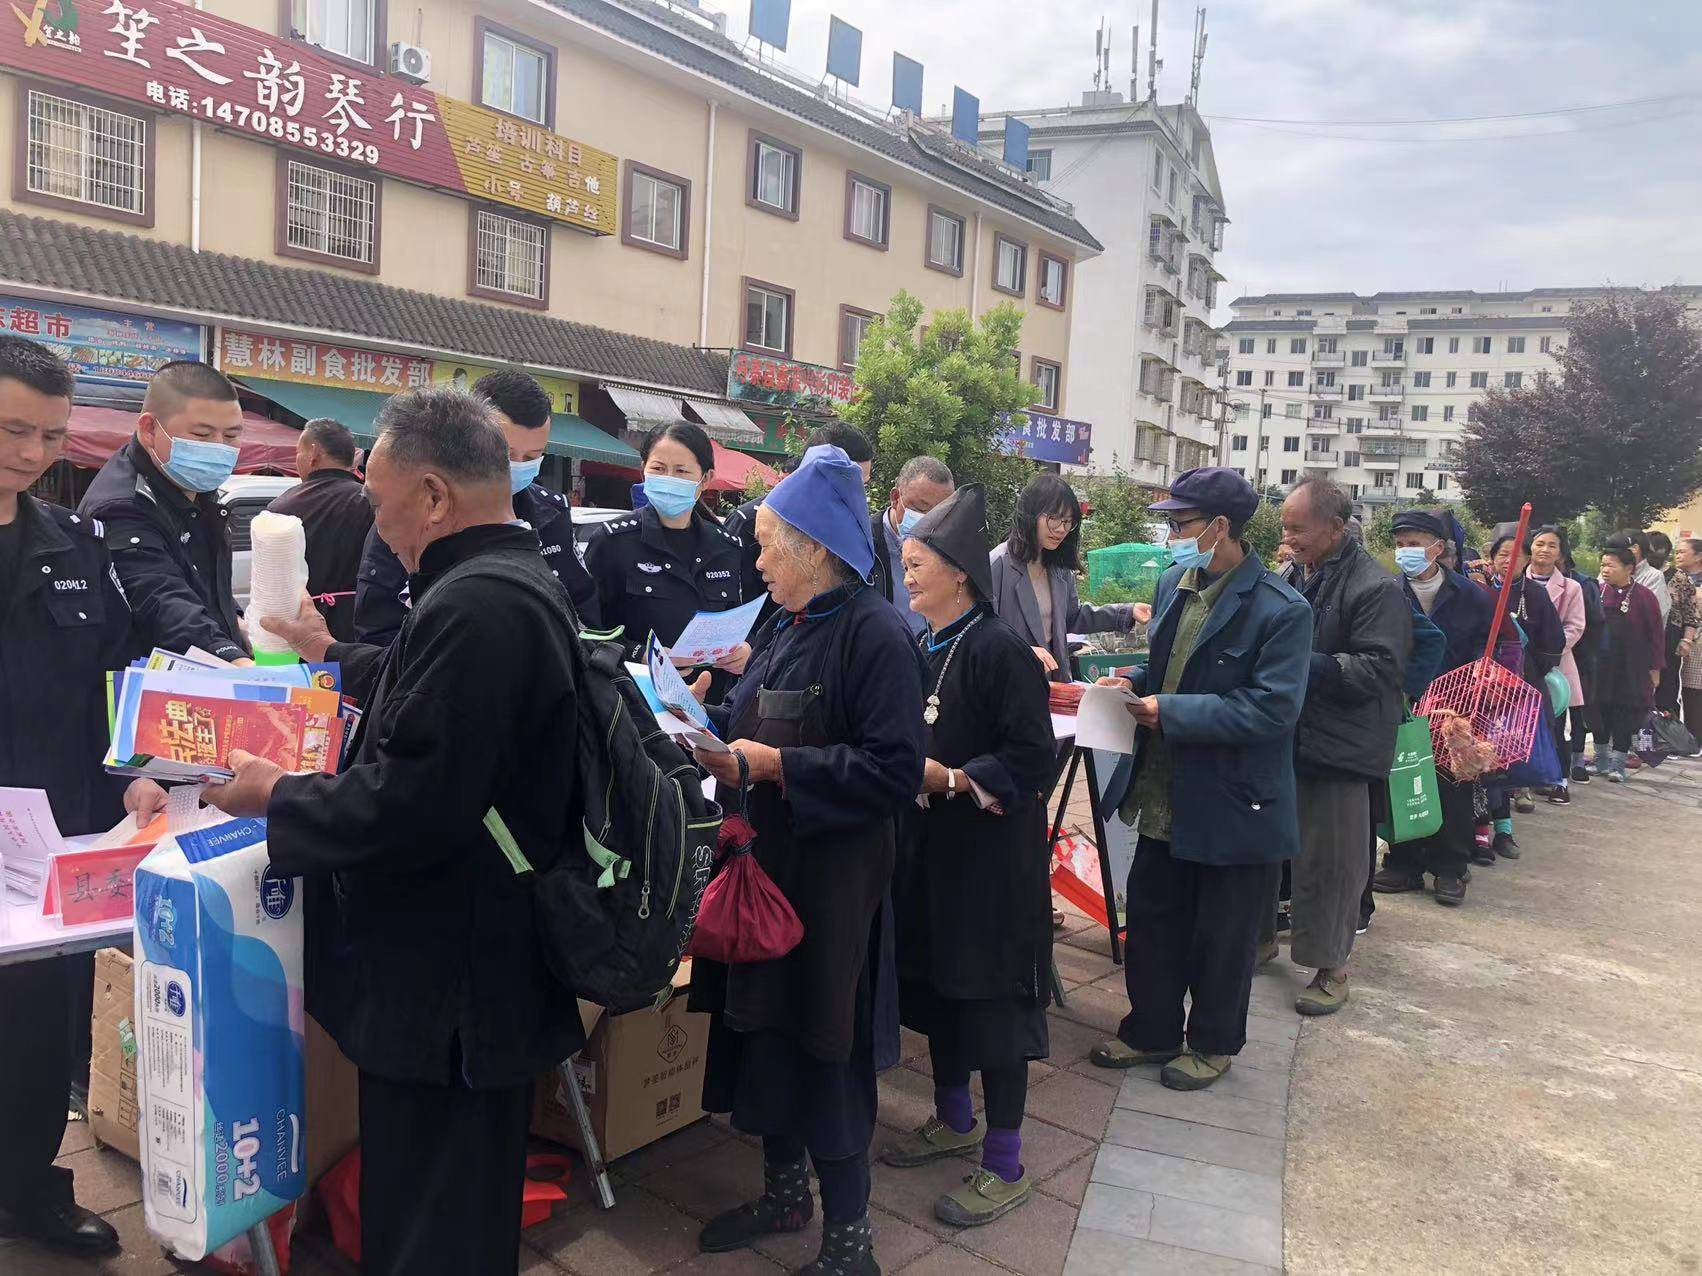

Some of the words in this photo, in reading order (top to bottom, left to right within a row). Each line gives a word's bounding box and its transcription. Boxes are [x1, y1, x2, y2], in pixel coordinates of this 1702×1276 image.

[100, 0, 437, 151] 笙之韵琴行
[495, 118, 583, 168] 培训科目
[484, 174, 524, 202] 小号
[546, 192, 599, 224] 葫芦丝
[566, 168, 601, 196] 吉他
[223, 333, 434, 389] 慧林副食批发部
[541, 544, 562, 556] 1080
[706, 571, 731, 579] 020352
[54, 580, 88, 590] 020412
[206, 825, 253, 848] CHANVEE
[231, 1116, 261, 1202] 10+2
[275, 1108, 288, 1184] CHANVEE
